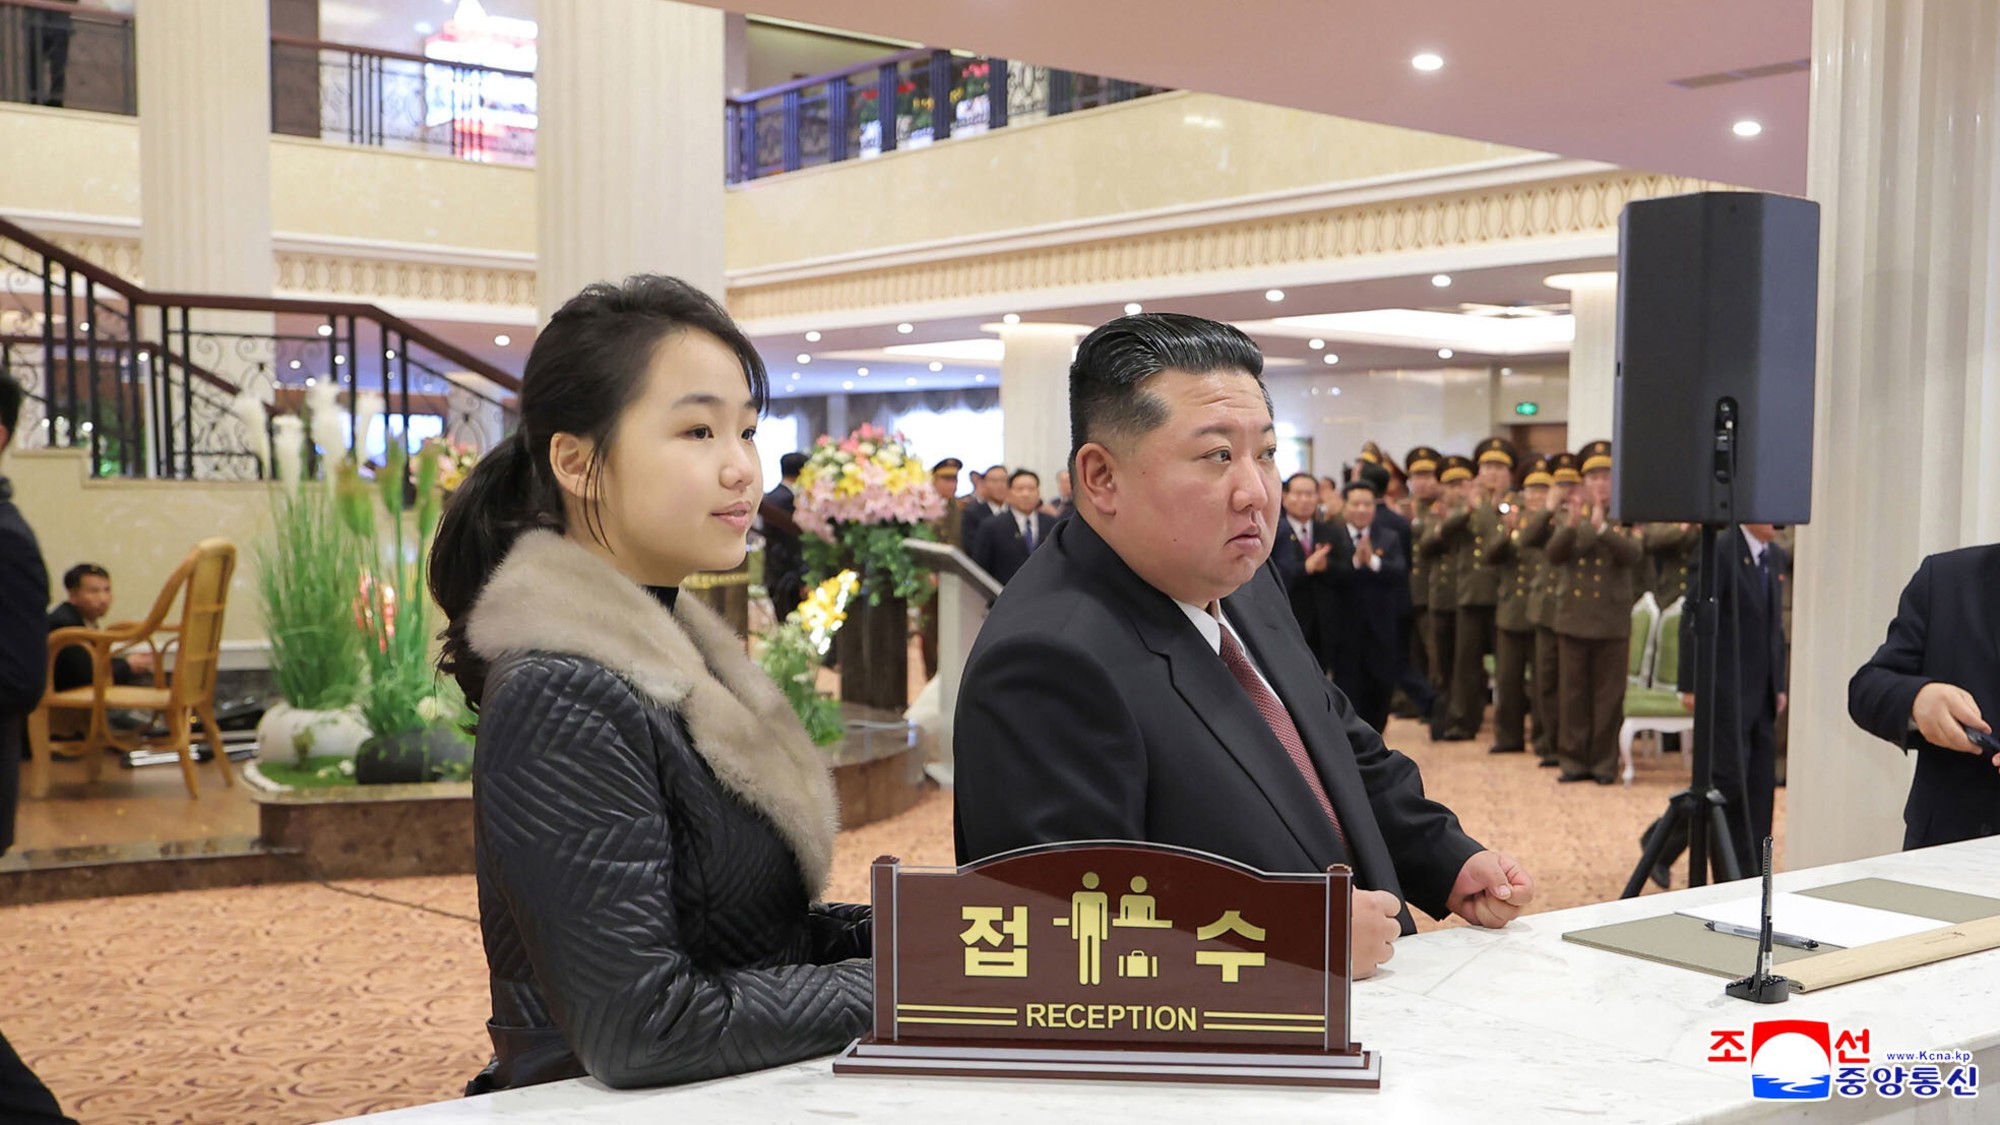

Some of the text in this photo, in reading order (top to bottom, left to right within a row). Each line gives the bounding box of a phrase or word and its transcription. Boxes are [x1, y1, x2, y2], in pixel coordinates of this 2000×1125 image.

[959, 905, 1266, 982] 접 수
[1026, 1003, 1197, 1031] RECEPTION
